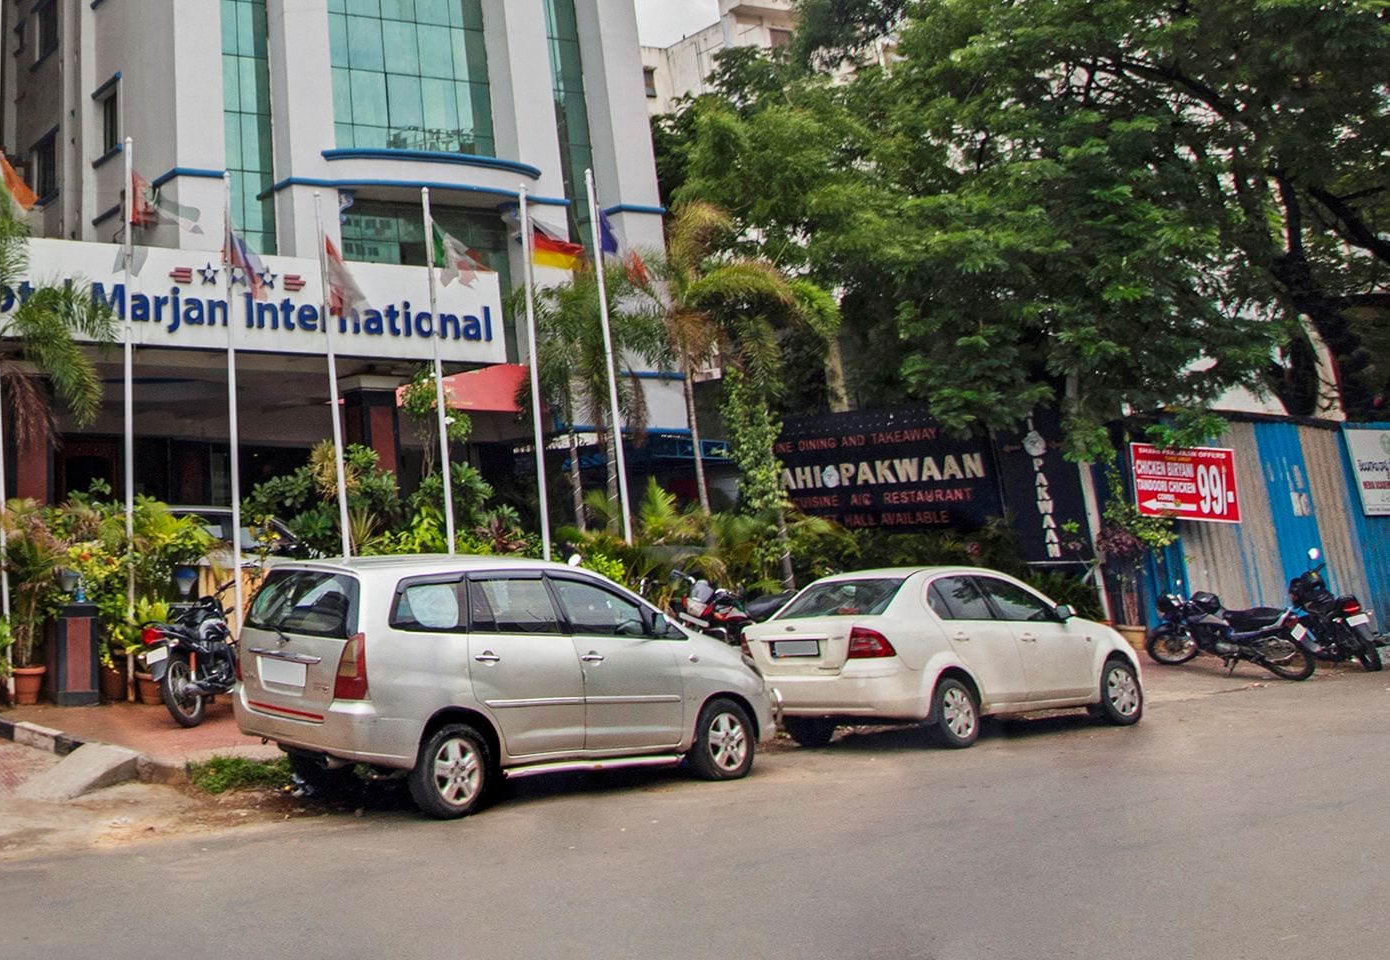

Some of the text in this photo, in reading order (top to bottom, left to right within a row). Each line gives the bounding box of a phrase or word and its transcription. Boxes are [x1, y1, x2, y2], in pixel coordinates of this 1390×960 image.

[91, 282, 228, 333] Marjan
[244, 292, 493, 342] International
[772, 427, 938, 453] INE DINING AND TAKEAWAY
[1198, 451, 1227, 460] OFFERS
[780, 452, 986, 490] AHI PAKWAAN
[1136, 460, 1194, 478] CHICKEN BIRYANI
[883, 487, 973, 504] RESTAURANT
[1168, 481, 1197, 494] CHICKEN
[1032, 458, 1062, 558] PAKWAAN
[881, 510, 949, 526] AVAILABLE
